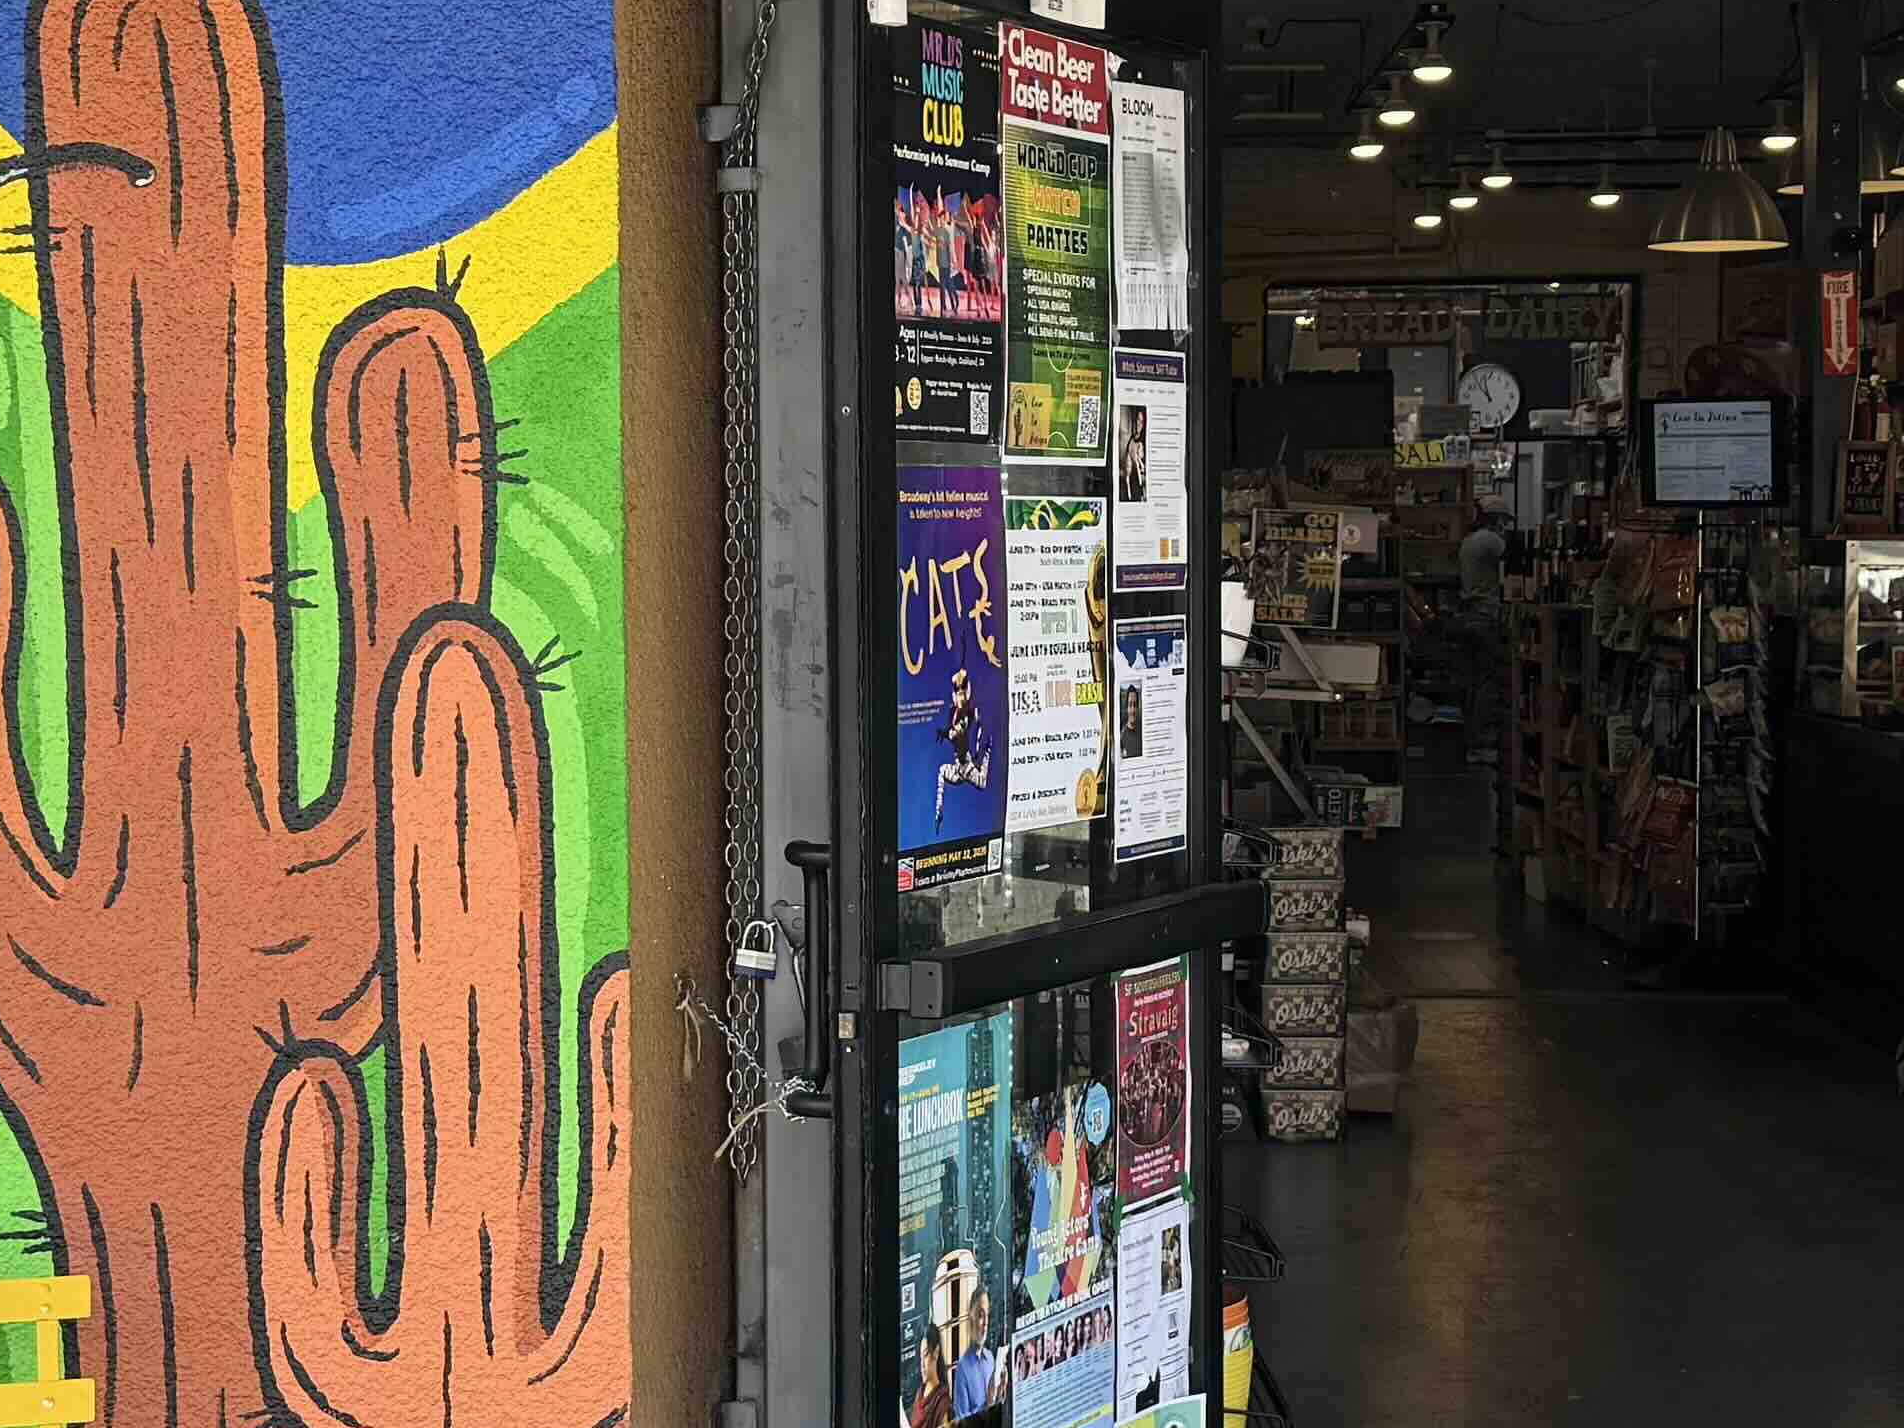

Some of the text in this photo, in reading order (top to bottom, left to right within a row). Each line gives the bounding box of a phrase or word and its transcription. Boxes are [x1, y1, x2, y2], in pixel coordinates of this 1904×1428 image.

[1007, 27, 1095, 84] Clean Beer
[921, 63, 964, 104] MUSIC
[1007, 68, 1103, 125] Taste Better
[922, 98, 964, 148] CLUB
[1121, 97, 1154, 118] BLOOM
[1016, 143, 1097, 181] WORLD CUP
[1027, 222, 1089, 255] PARTIES
[1022, 268, 1053, 285] SPECIAL
[1081, 276, 1097, 290] FOR
[1320, 302, 1453, 340] BREAD
[1488, 298, 1618, 335] DAIRY
[899, 537, 1002, 676] CATS
[948, 850, 962, 862] MAY
[1274, 890, 1335, 919] Oski's
[1277, 945, 1336, 973] Oski's
[1128, 1003, 1178, 1037] Stravaig
[1275, 997, 1333, 1024] Oski's
[898, 1104, 912, 1142] HE
[913, 1088, 964, 1137] LUNCHBOX
[1275, 1105, 1334, 1132] Oski's
